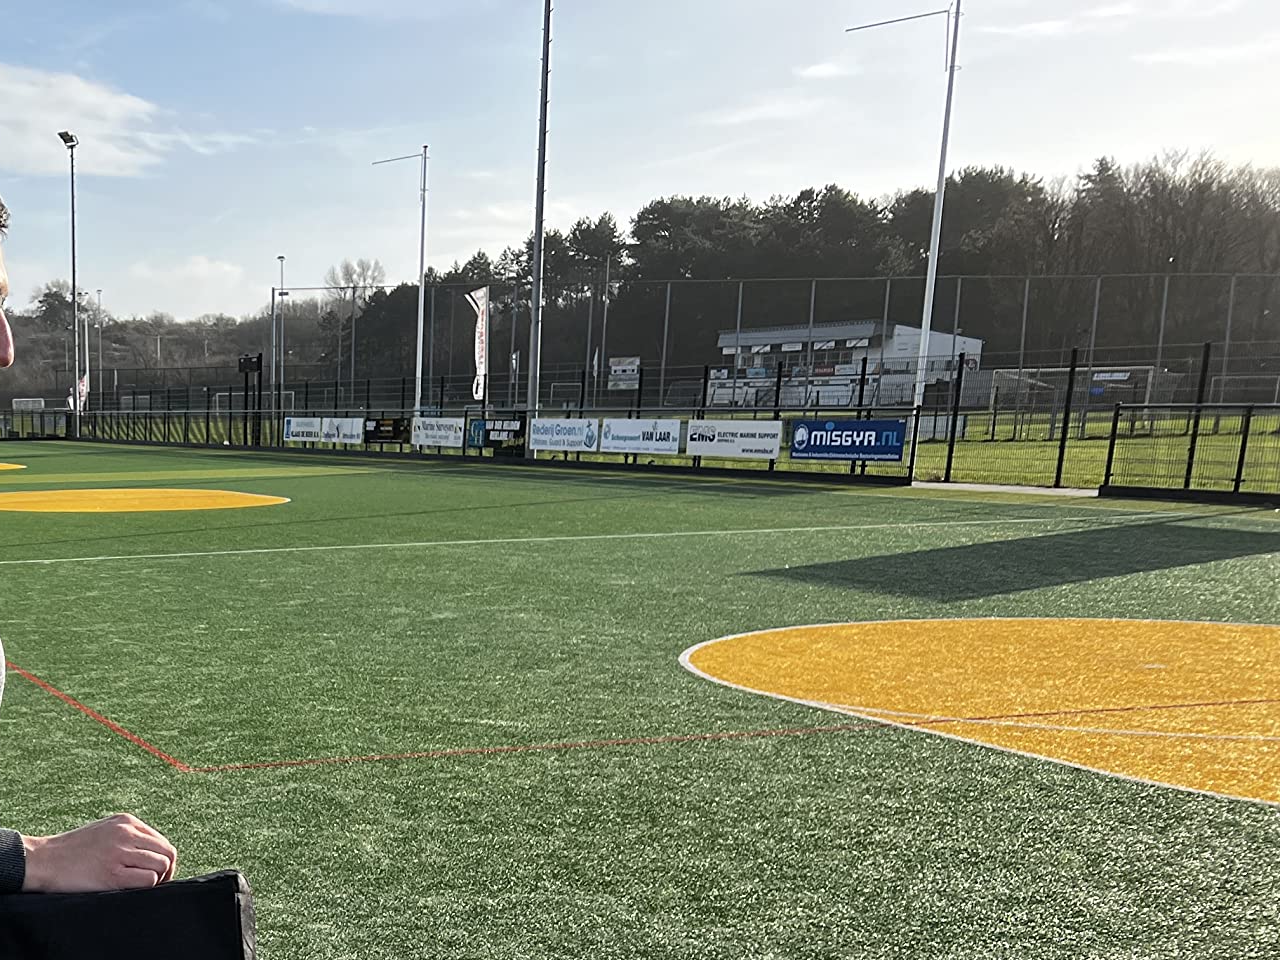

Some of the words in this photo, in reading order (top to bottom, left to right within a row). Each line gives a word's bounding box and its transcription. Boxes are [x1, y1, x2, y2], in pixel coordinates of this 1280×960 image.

[641, 431, 654, 442] VAN
[655, 431, 671, 442] LAAR
[718, 431, 738, 439] ELECTRIC
